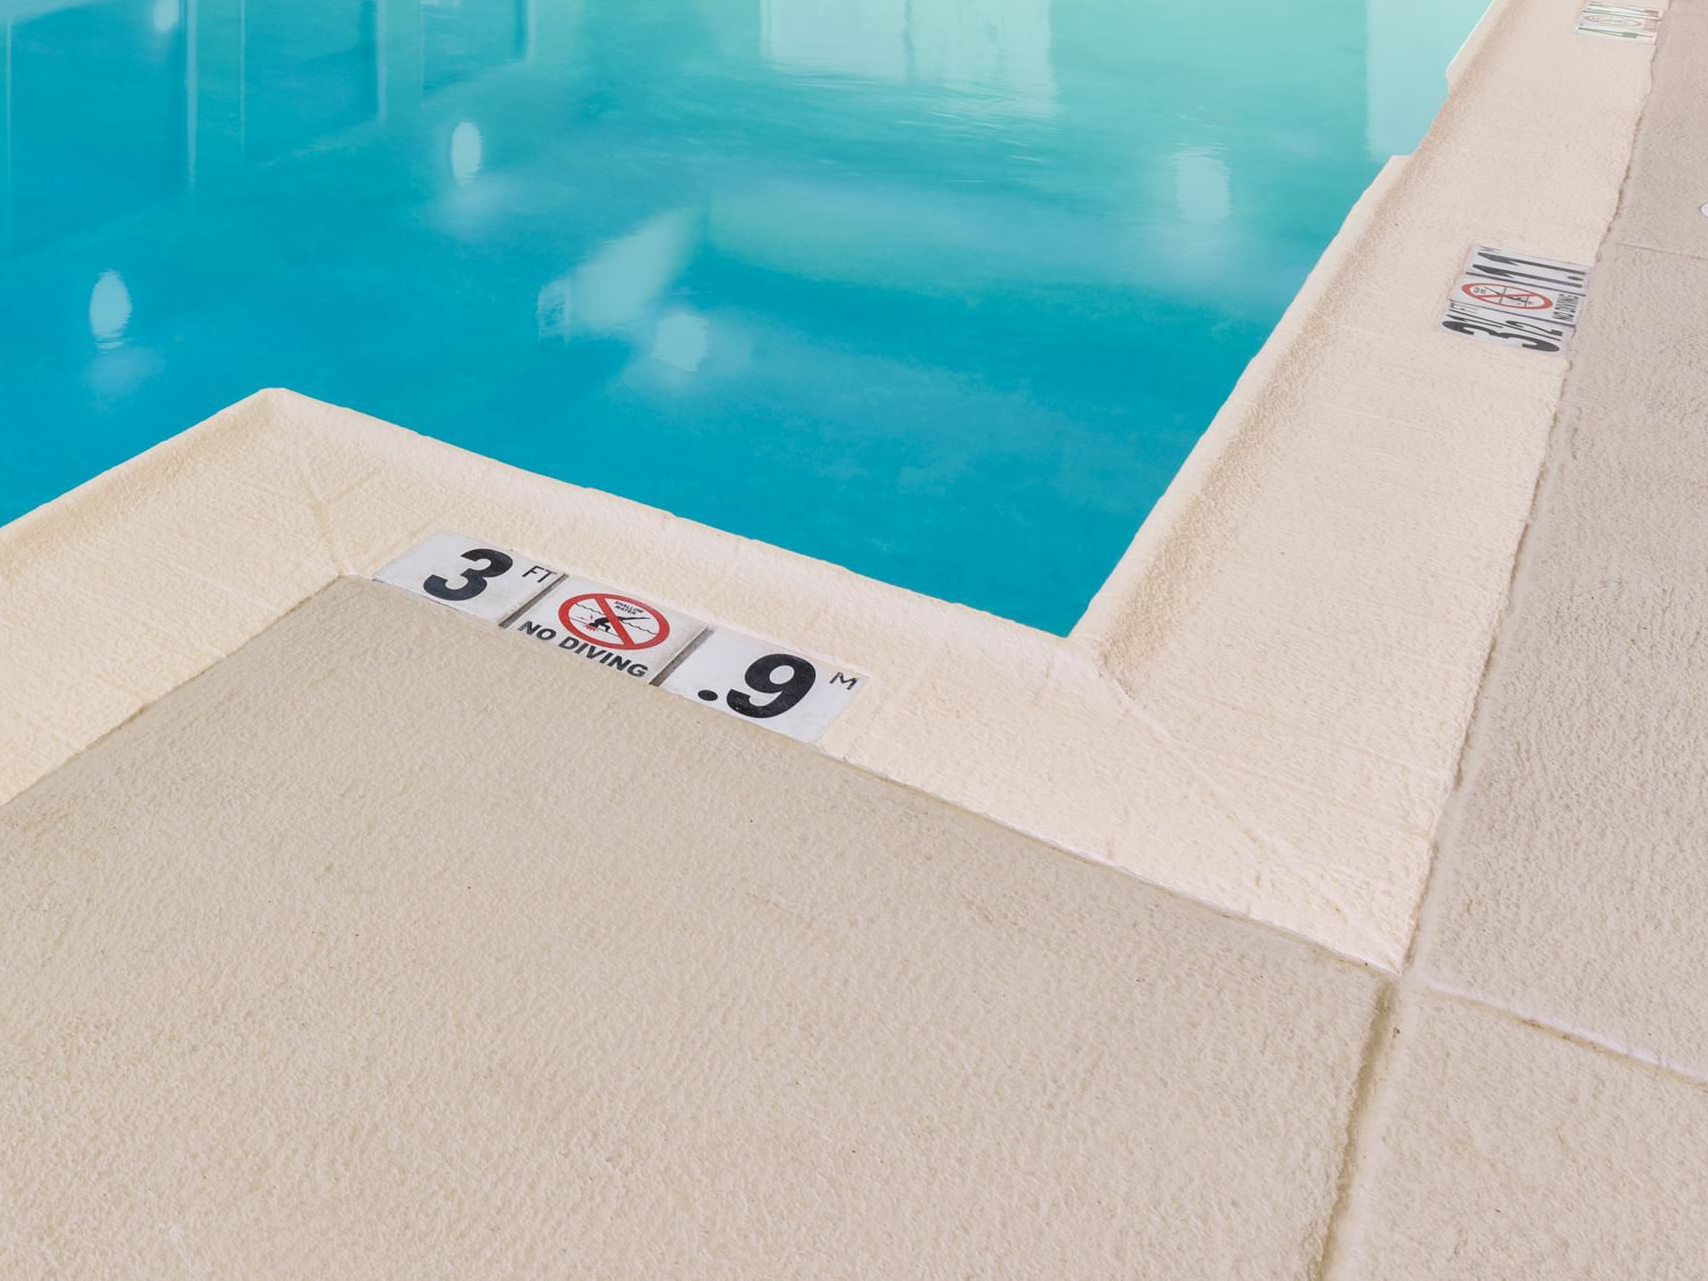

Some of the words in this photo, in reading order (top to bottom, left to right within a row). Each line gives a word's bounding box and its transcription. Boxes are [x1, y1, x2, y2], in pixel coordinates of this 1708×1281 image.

[422, 548, 514, 602] 3
[521, 565, 557, 584] FT
[614, 600, 644, 613] SHALLOW
[615, 605, 637, 616] WATER
[517, 620, 557, 641] NO
[558, 636, 649, 678] DIVING
[697, 653, 817, 719] .9
[829, 671, 858, 691] M
